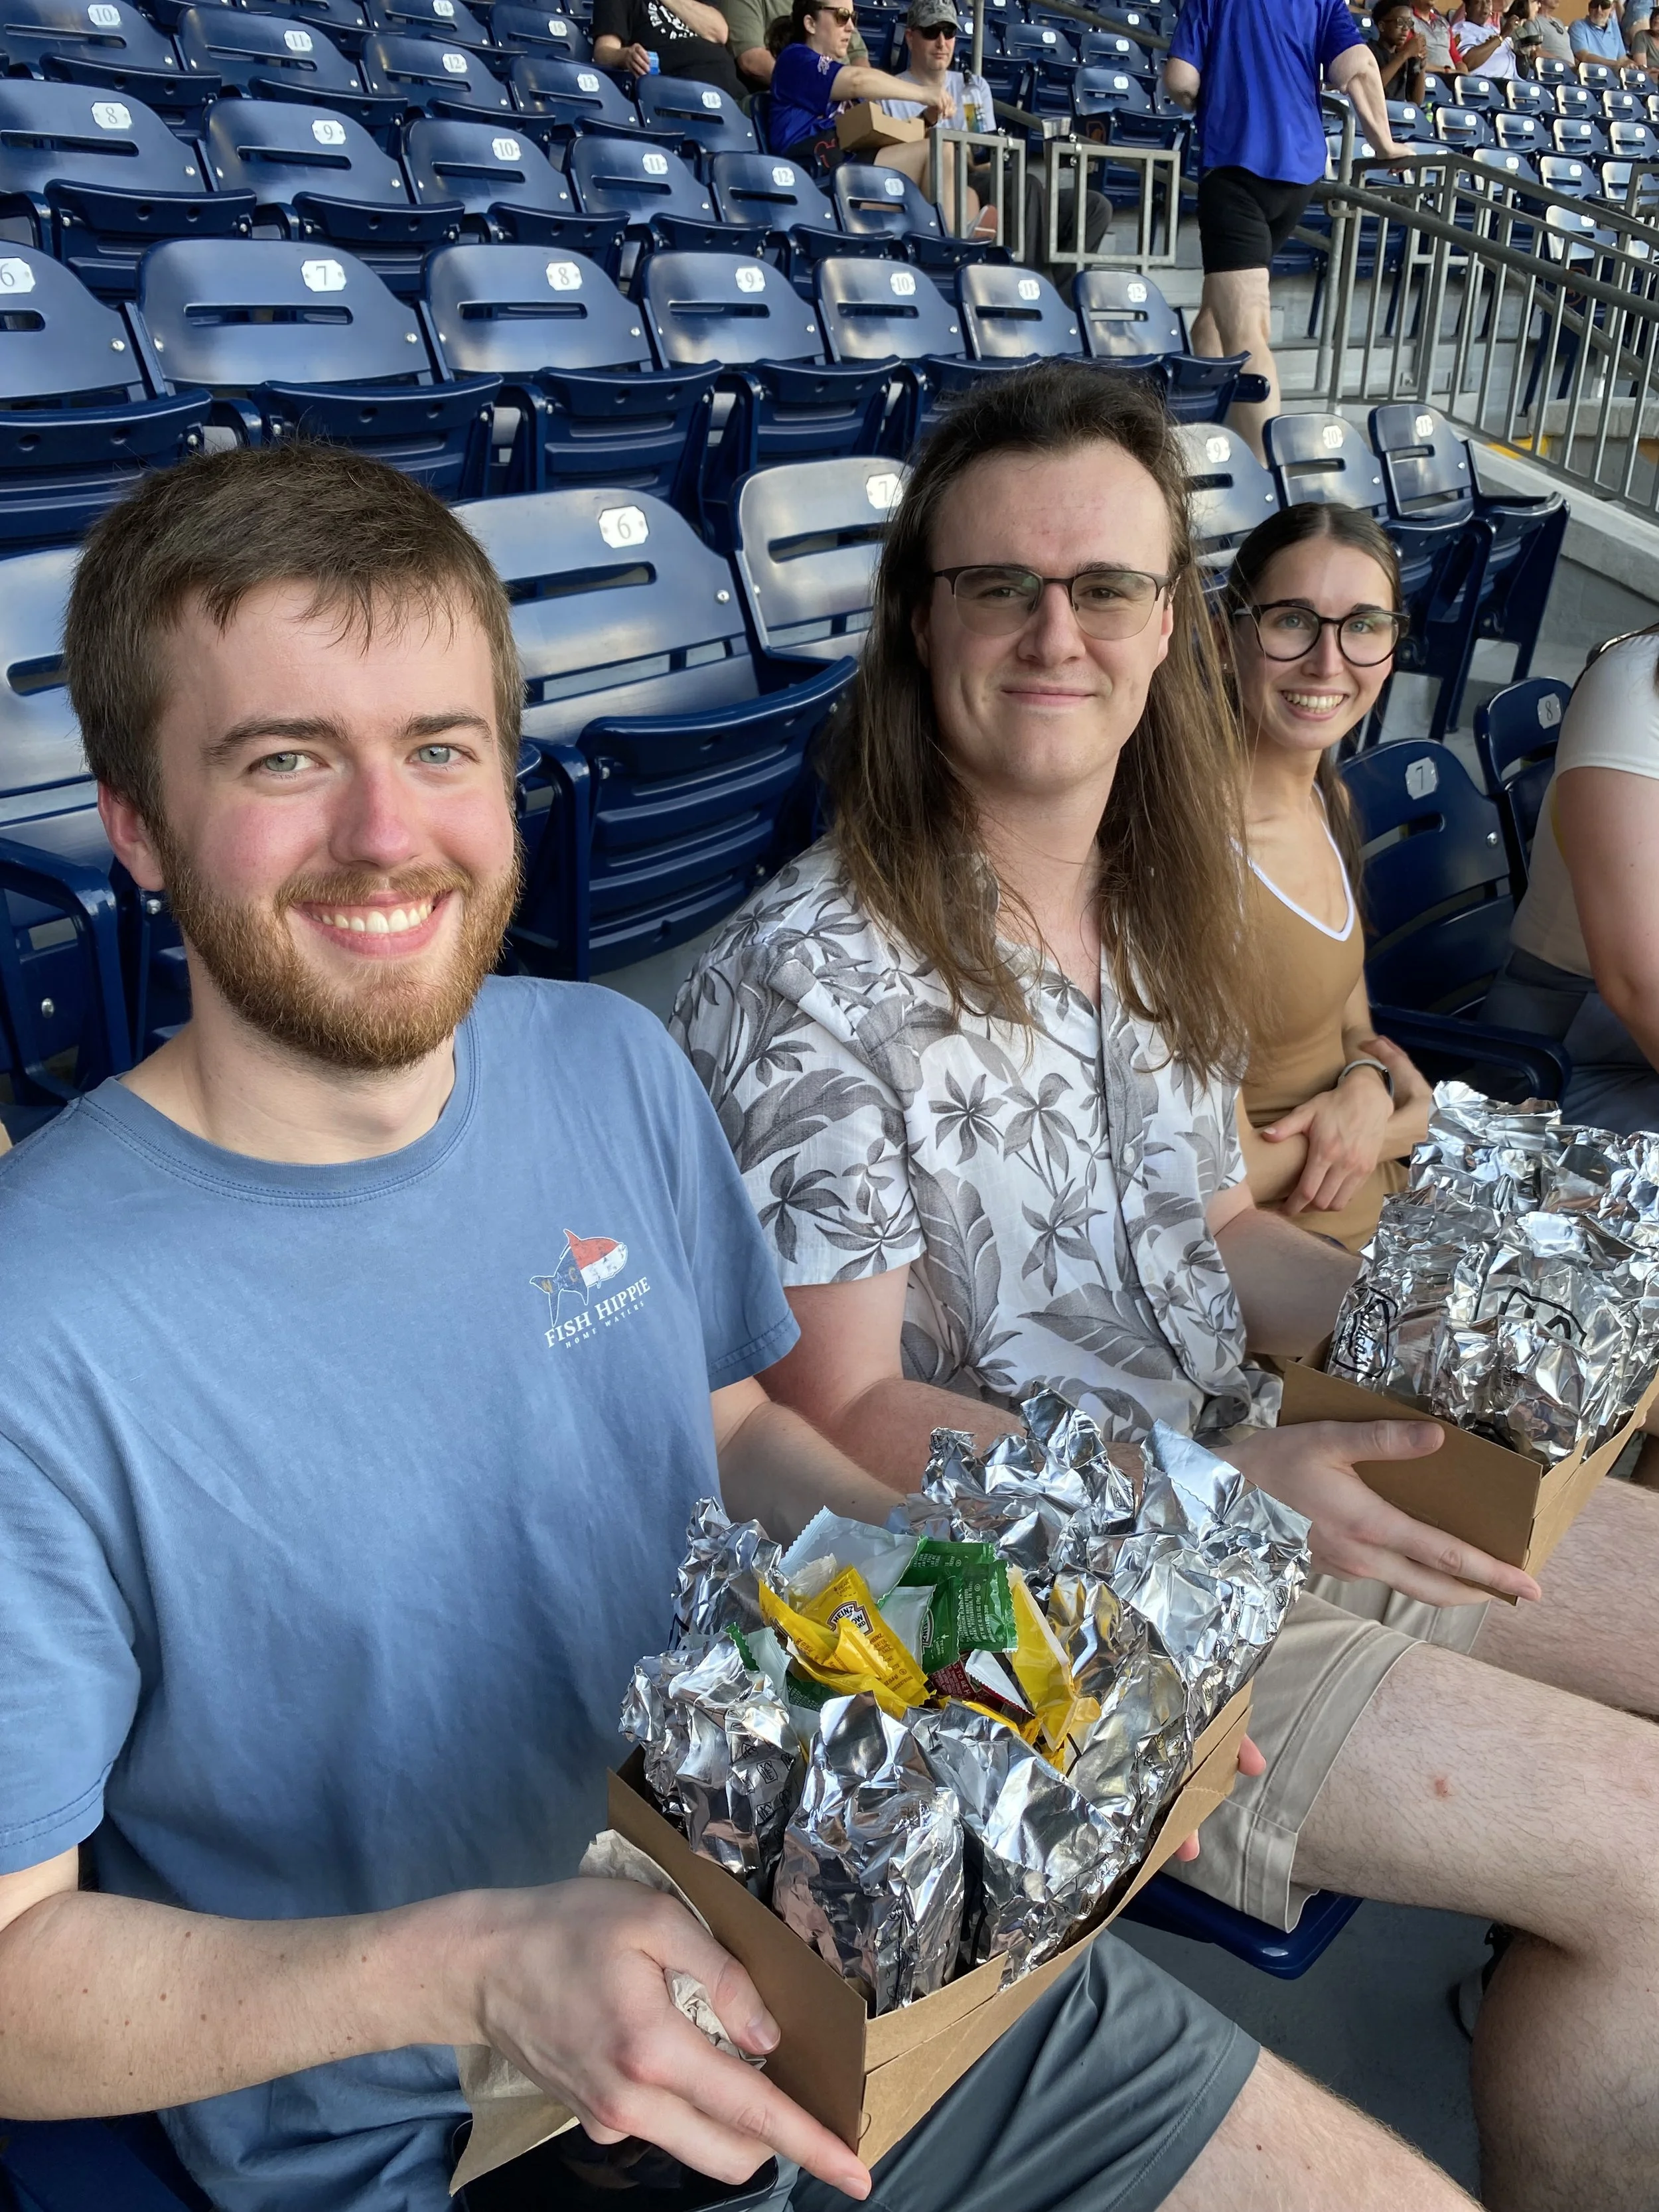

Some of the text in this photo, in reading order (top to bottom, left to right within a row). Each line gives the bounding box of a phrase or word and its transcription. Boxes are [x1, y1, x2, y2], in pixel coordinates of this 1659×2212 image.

[95, 8, 112, 23] 10
[292, 34, 305, 47] 11
[449, 56, 461, 69] 12
[105, 106, 118, 125] 8
[323, 124, 334, 141] 9
[500, 141, 514, 157] 10
[650, 157, 661, 172] 11
[778, 170, 789, 183] 12
[1, 263, 15, 288] 6
[315, 265, 328, 287] 7
[559, 267, 571, 286] 8
[745, 271, 755, 289] 9
[897, 276, 910, 292] 10
[1024, 283, 1035, 297] 11
[1132, 286, 1142, 299] 12
[1419, 419, 1429, 433] 11
[1327, 429, 1339, 445] 10
[1213, 441, 1222, 460] 9
[877, 480, 889, 502] 7
[616, 512, 632, 540] 6
[1545, 700, 1553, 722] 8
[1415, 765, 1425, 791] 7
[544, 1276, 652, 1349] FISH HIPPIE
[565, 1300, 645, 1349] HOME WATERS
[832, 1605, 854, 1623] HEINZ
[956, 1669, 969, 1690] TO BE
